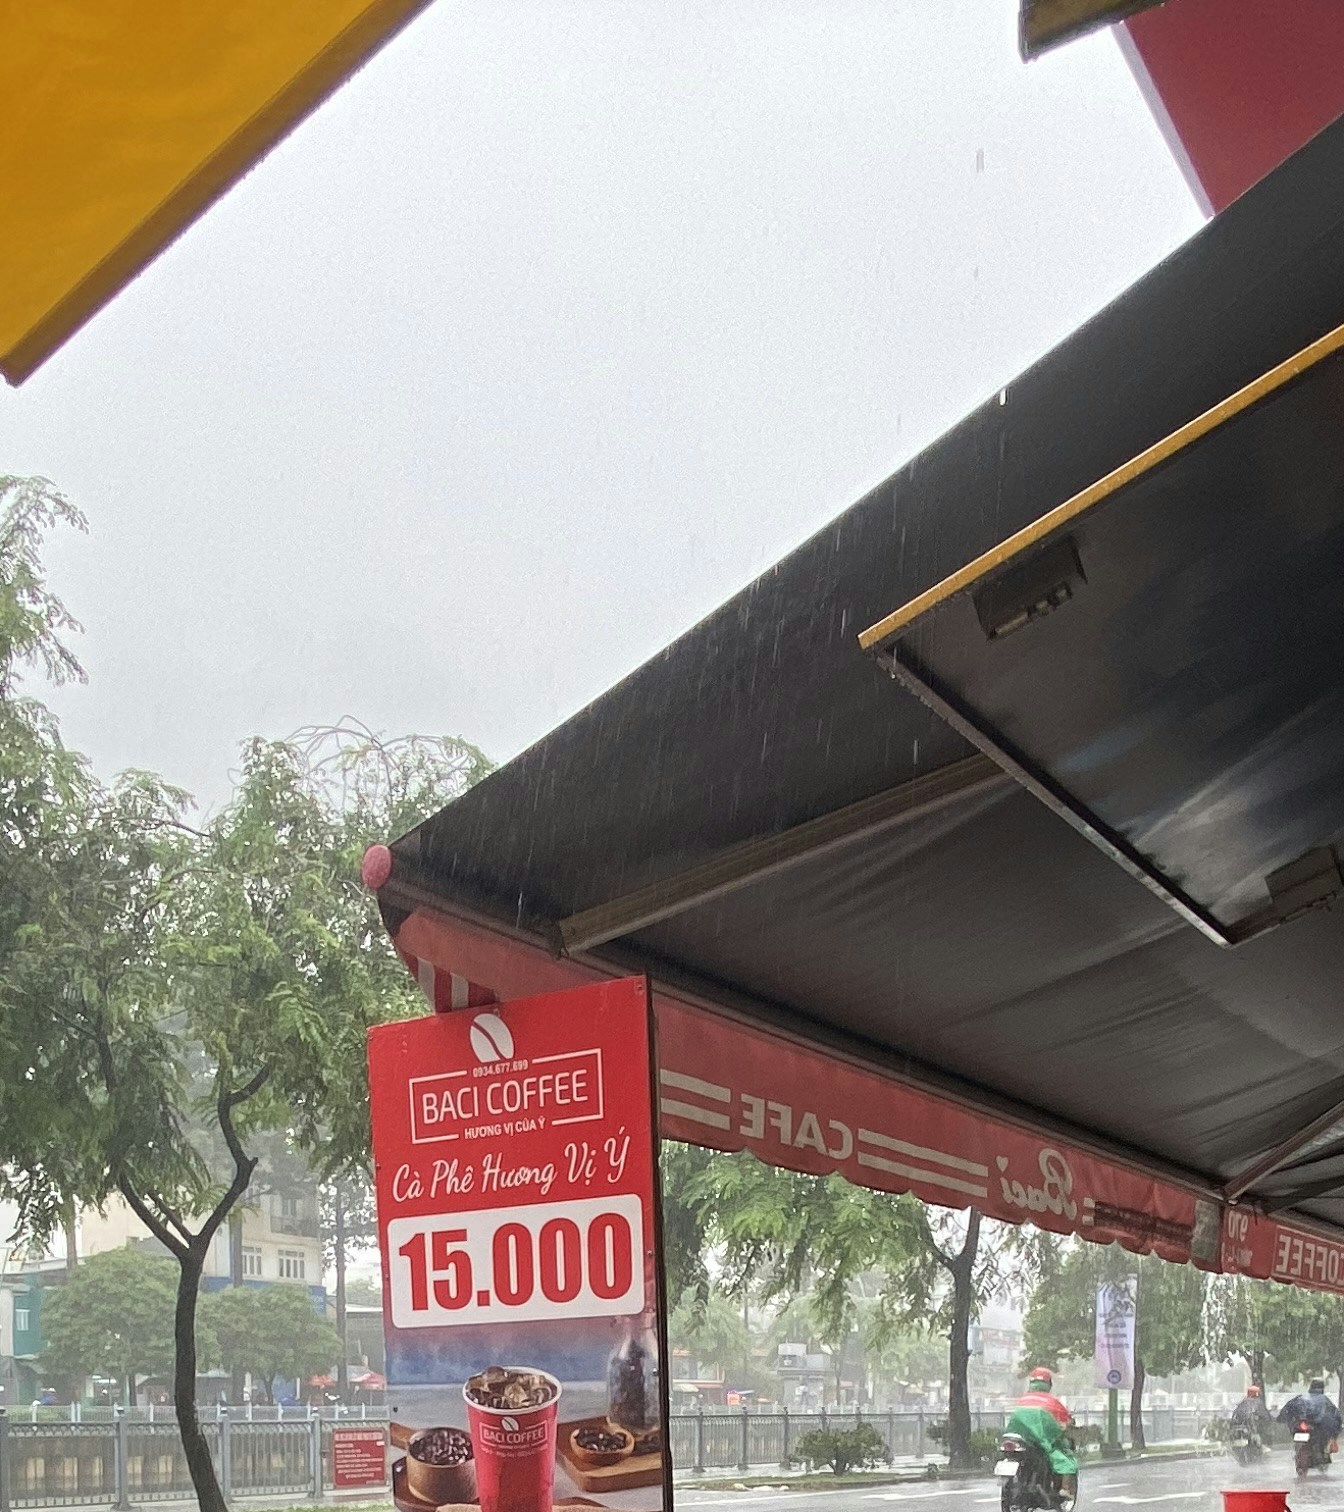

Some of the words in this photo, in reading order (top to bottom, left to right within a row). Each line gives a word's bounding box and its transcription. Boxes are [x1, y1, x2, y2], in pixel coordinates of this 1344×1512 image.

[421, 1085, 479, 1125] BACI
[486, 1069, 589, 1116] COFFEE
[472, 1059, 529, 1078] 0934.677.699
[392, 1164, 425, 1203] Cà
[429, 1154, 475, 1199] Phê
[480, 1153, 559, 1195] Hương
[564, 1142, 597, 1187] Vị
[603, 1126, 631, 1184] Ý
[398, 1212, 634, 1312] 15.000
